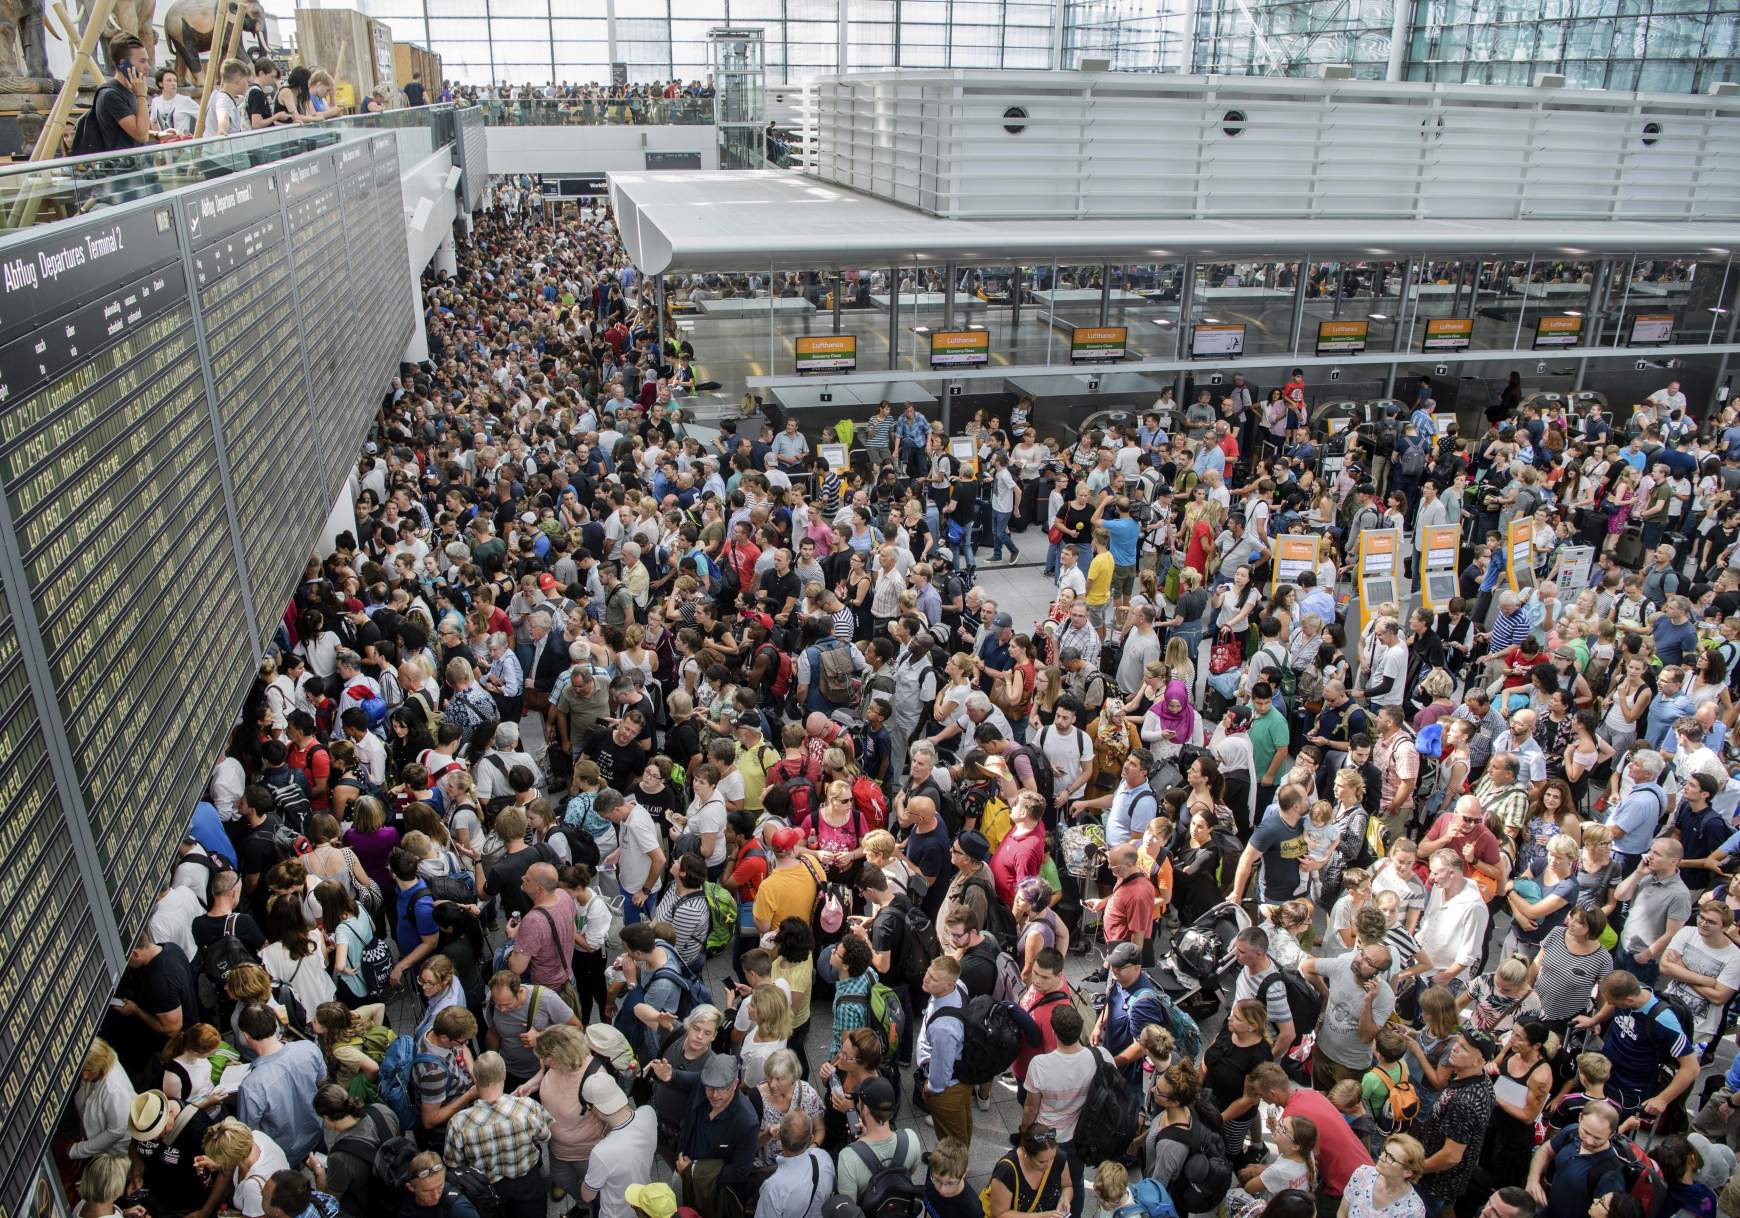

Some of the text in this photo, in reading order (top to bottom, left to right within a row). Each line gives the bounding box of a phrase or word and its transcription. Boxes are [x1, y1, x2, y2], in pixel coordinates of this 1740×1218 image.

[3, 226, 124, 293] Abflug Departures Terminal 2
[0, 413, 16, 442] LH
[15, 398, 41, 431] 2472
[44, 376, 75, 412] London
[8, 449, 24, 479] LH
[24, 432, 48, 467] 2452
[52, 413, 74, 446] Oslo
[17, 486, 33, 515] LH
[32, 467, 56, 502] 1784
[59, 440, 89, 479] Ankara
[26, 521, 41, 550] LH
[41, 501, 63, 536] 1962
[67, 451, 120, 512] Lamezia-Terme
[34, 555, 49, 583] LH
[49, 533, 71, 568] 1810
[74, 492, 113, 543] Barcelona
[43, 588, 57, 617] LH
[56, 565, 78, 601] 2034
[81, 533, 109, 574] Berlin
[51, 620, 65, 650] LH
[64, 596, 86, 633] 1964
[89, 558, 119, 604] Catania
[59, 652, 73, 682] LH
[72, 627, 93, 664] 1758
[96, 579, 132, 635] Heraklion
[103, 603, 141, 664] Luxembourg
[87, 687, 107, 726] 8166
[110, 643, 138, 693] Tallinn
[116, 685, 134, 722] Bari
[123, 697, 149, 749] Rostock
[98, 802, 110, 832] LH
[0, 830, 41, 908] delayed
[8, 862, 50, 942] delayed
[113, 857, 124, 887] LH
[18, 893, 59, 974] delayed
[29, 923, 68, 1006] delayed
[127, 911, 139, 941] LH
[39, 936, 85, 1036] Lufthansa
[29, 982, 85, 1109] K01 delayed
[58, 1011, 93, 1096] delayed
